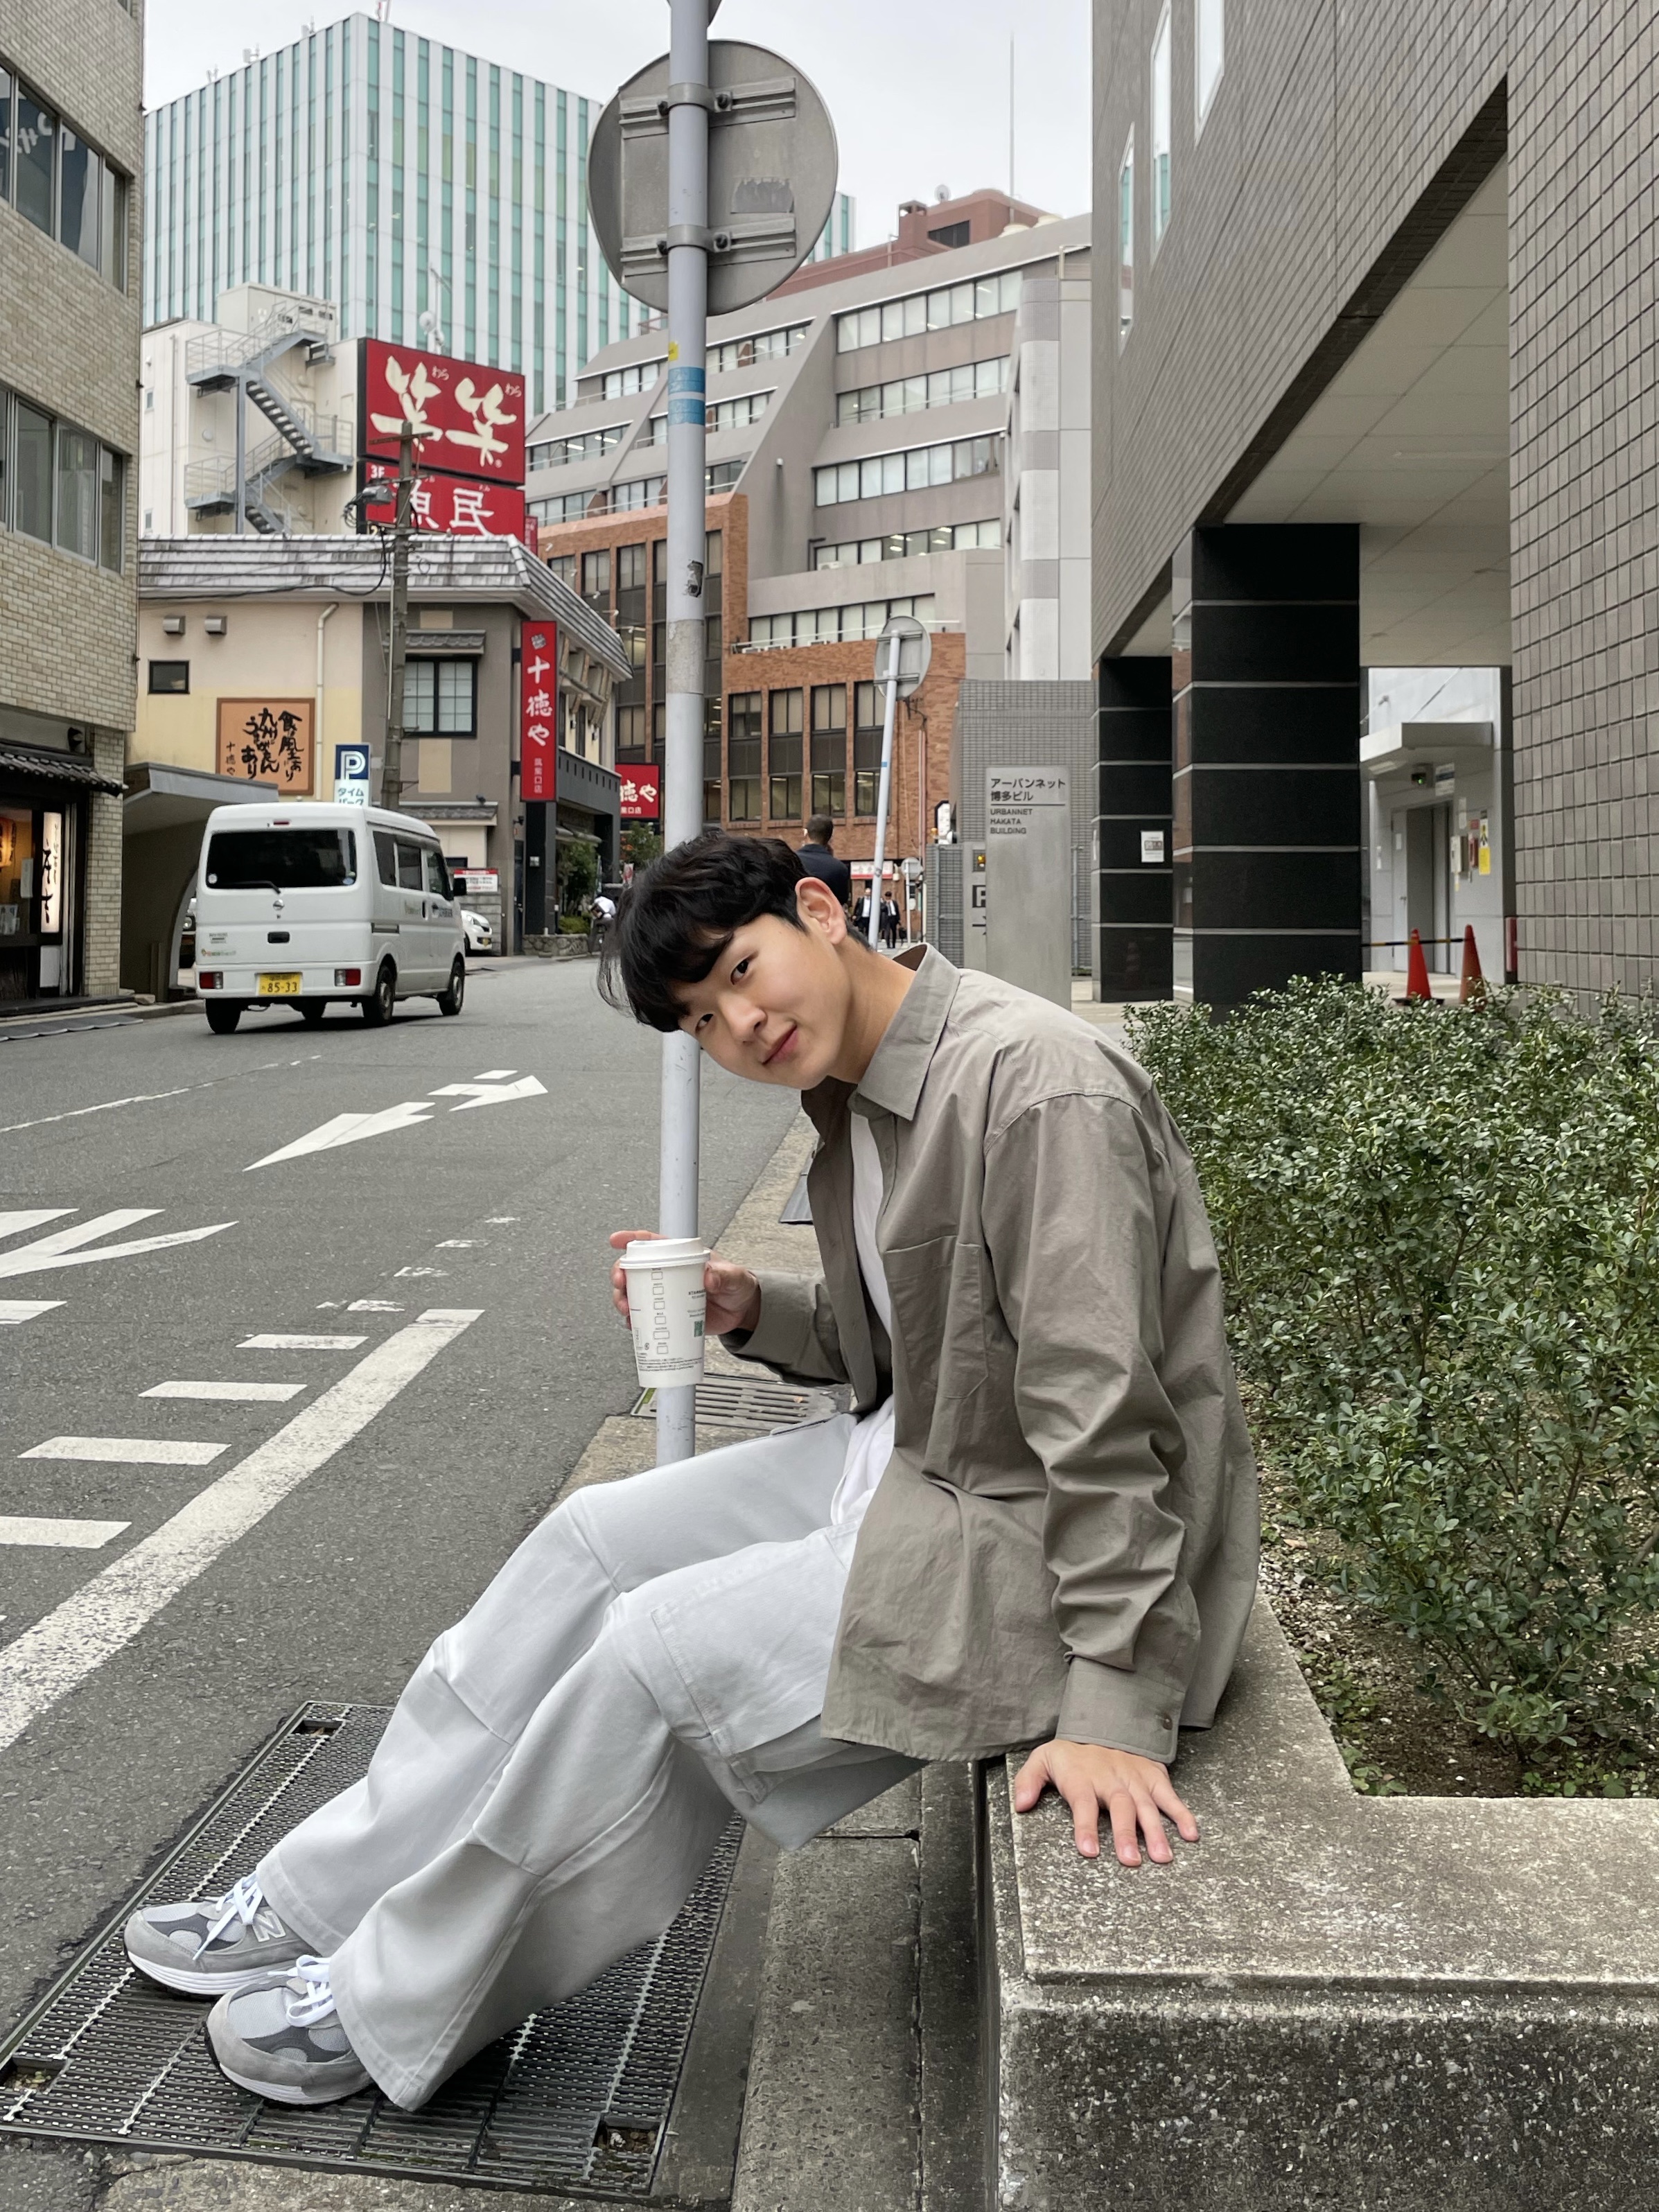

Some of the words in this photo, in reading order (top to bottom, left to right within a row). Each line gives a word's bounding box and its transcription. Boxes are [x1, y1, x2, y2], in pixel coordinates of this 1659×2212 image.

[526, 655, 553, 747] 十徳や
[340, 750, 366, 780] P
[338, 787, 365, 796] タイム
[991, 778, 1066, 789] アーバンネット
[991, 791, 1034, 801] 博多ビル
[252, 1910, 286, 1942] N
